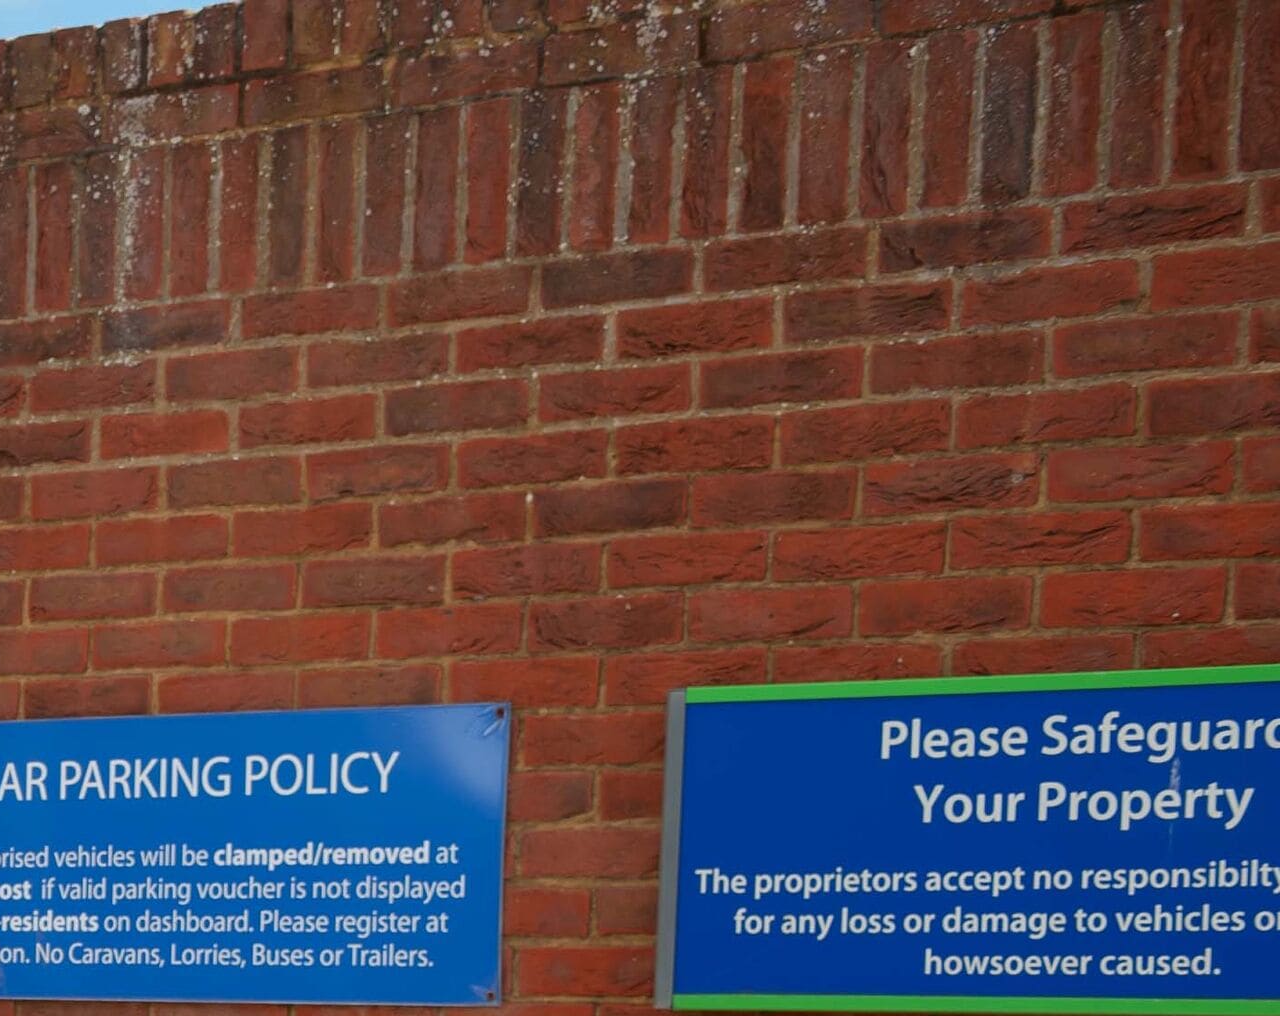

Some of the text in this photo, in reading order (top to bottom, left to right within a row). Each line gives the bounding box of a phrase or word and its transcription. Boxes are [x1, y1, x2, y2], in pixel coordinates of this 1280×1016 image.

[881, 718, 1028, 759] Please
[60, 756, 231, 800] PARKING
[245, 751, 400, 795] POLICY
[914, 780, 1255, 831] Your Property
[54, 845, 135, 867] vehicles
[140, 844, 176, 866] will
[182, 844, 209, 866] be
[214, 840, 430, 871] clamped/removed
[436, 844, 459, 864] at
[42, 877, 56, 899] if
[59, 877, 106, 900] valid
[112, 877, 191, 905] parking
[197, 876, 285, 899] voucher
[291, 877, 306, 899] is
[313, 879, 351, 899] not
[356, 875, 465, 904] displayed
[695, 868, 747, 893] The
[755, 867, 917, 899] proprietors
[925, 867, 1025, 897] accept
[1033, 870, 1072, 889] no
[104, 916, 130, 932] on
[136, 910, 254, 932] dashboard.
[260, 910, 329, 932] Please
[335, 911, 421, 938] register
[426, 913, 448, 933] at
[734, 908, 775, 934] for
[781, 915, 833, 940] any
[841, 907, 895, 933] loss
[904, 914, 935, 933] or
[942, 906, 1066, 939] damage
[1074, 909, 1107, 932] to
[1116, 904, 1245, 932] vehicles
[36, 942, 64, 964] No
[68, 942, 165, 967] Caravans,
[171, 944, 246, 968] Lorries,
[252, 943, 314, 966] Buses
[320, 949, 344, 966] or
[347, 943, 433, 967] Trailers.
[925, 948, 1221, 975] howsoever caused.
